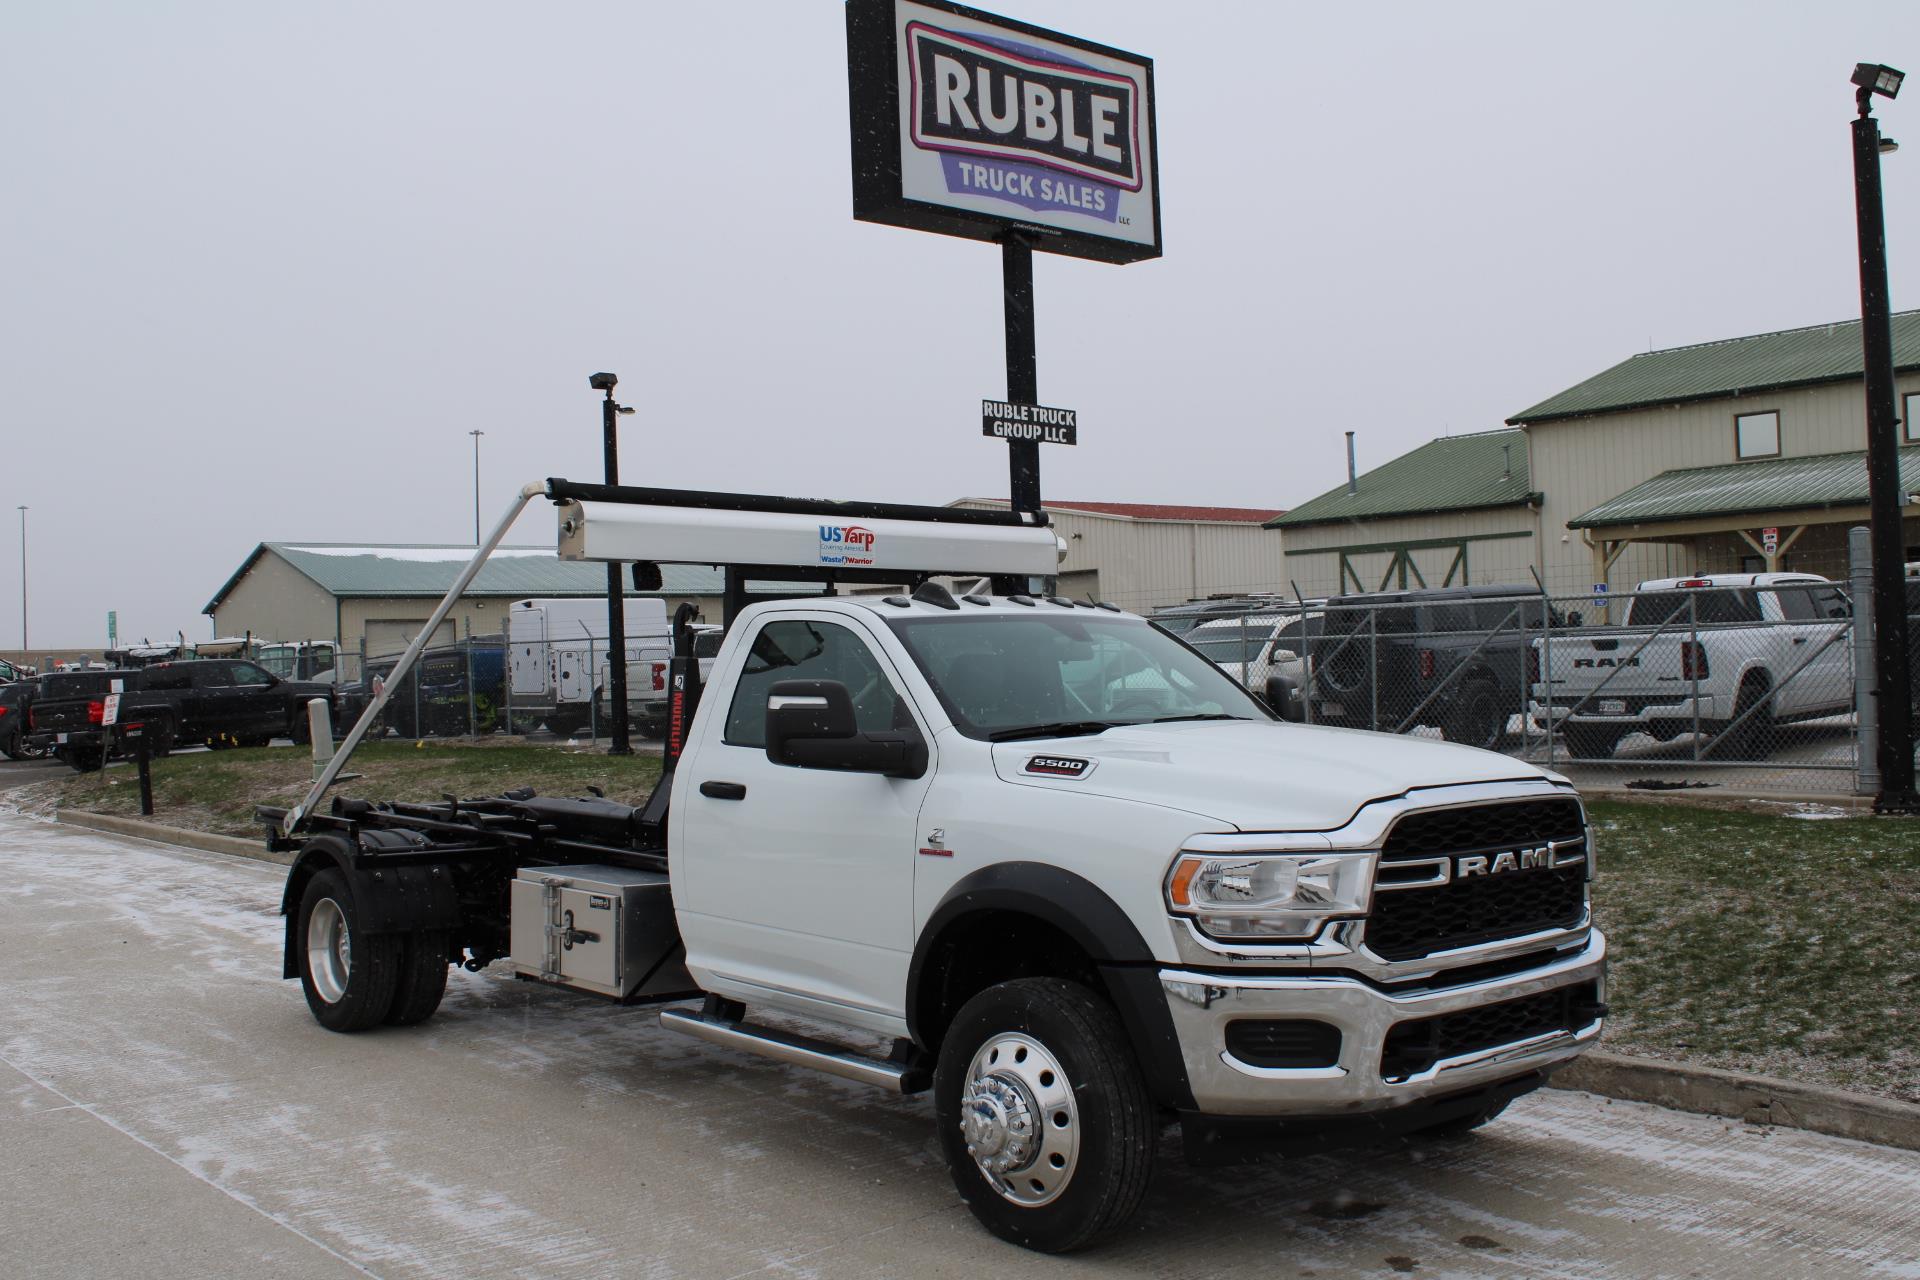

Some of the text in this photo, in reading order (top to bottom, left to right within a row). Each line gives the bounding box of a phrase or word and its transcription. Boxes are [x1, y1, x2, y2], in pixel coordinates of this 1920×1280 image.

[934, 53, 1122, 164] RUBLE
[958, 161, 1106, 212] TRUCK SALES
[1118, 215, 1131, 226] LLC
[983, 401, 1075, 426] RUBLE TRUCK
[993, 421, 1067, 443] GROUP LLC
[1573, 657, 1640, 668] RAM
[671, 692, 683, 756] MULTILIFT
[1034, 758, 1083, 769] 5500
[1457, 847, 1548, 878] RAM
